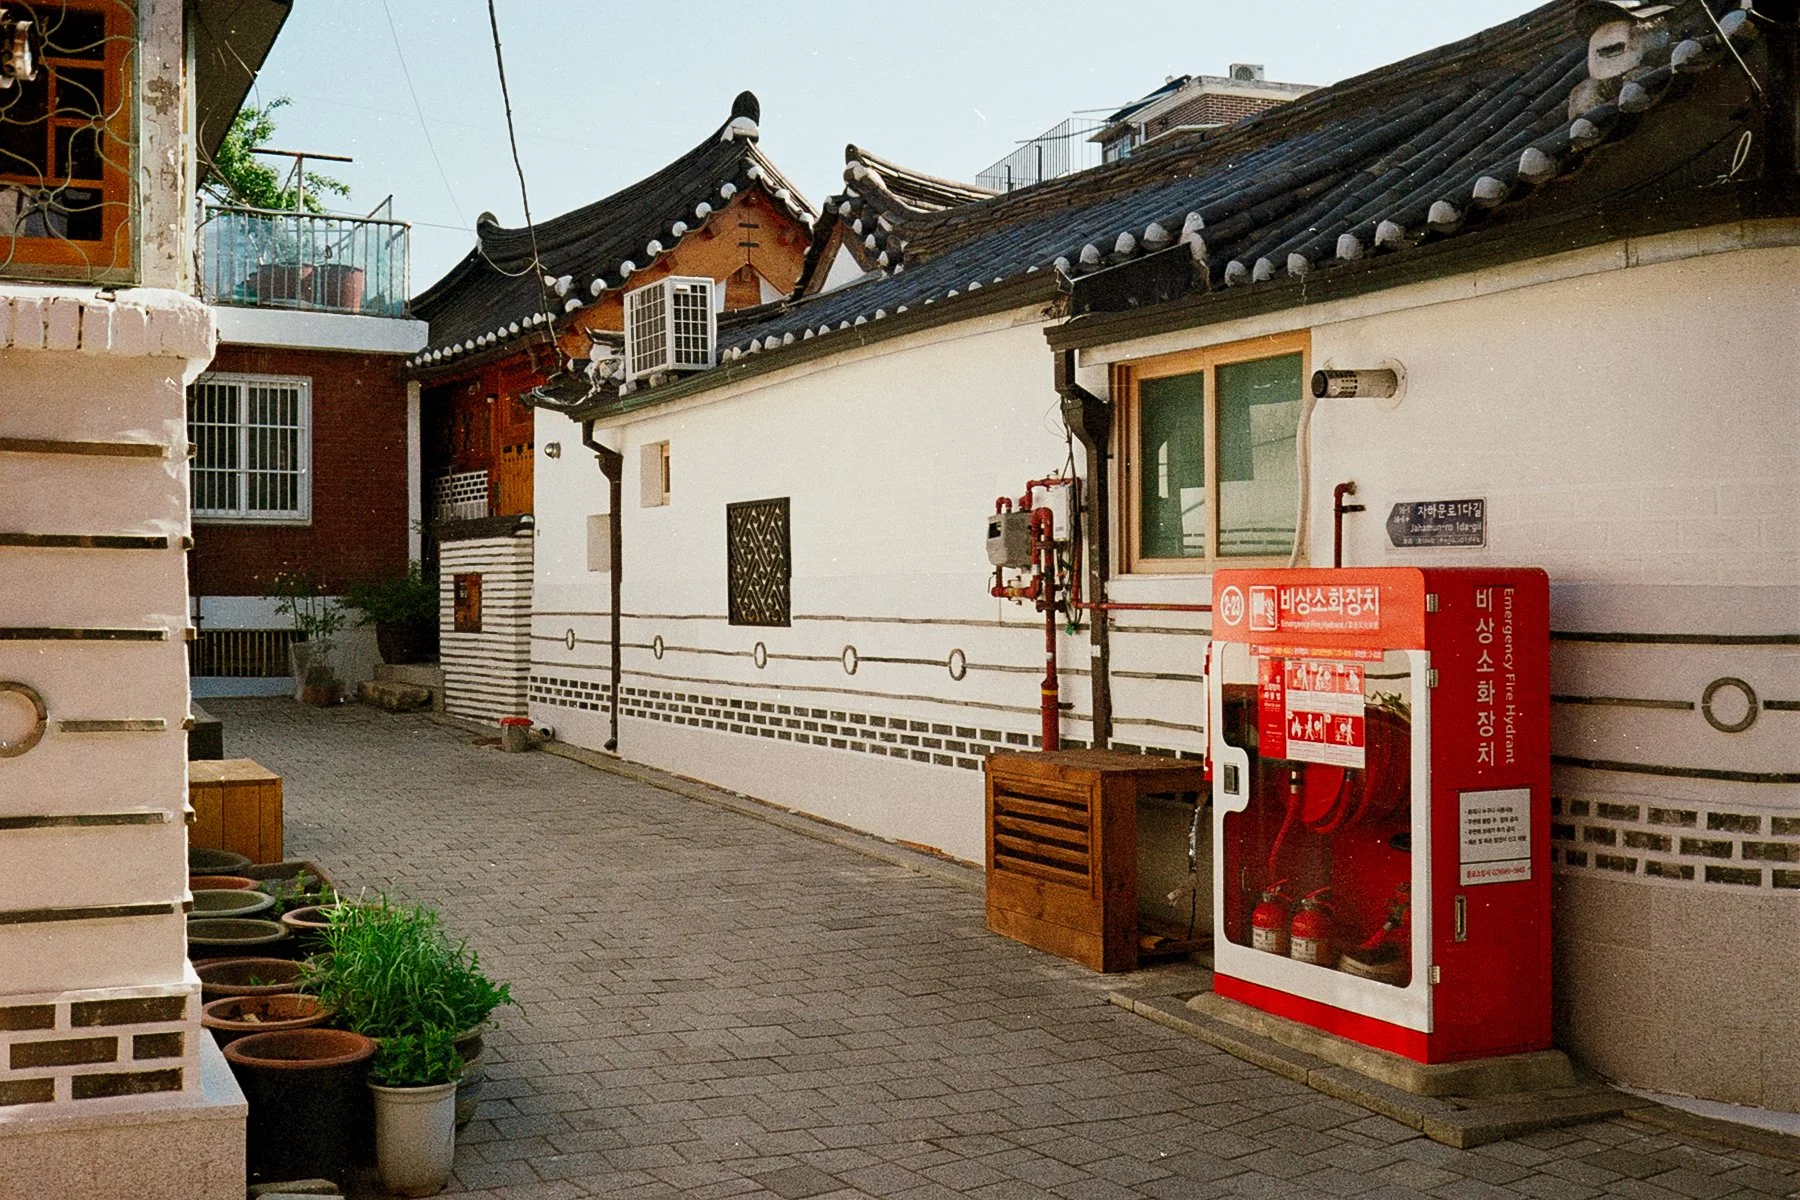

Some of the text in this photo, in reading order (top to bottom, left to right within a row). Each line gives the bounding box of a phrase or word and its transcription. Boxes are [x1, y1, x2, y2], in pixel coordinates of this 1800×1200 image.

[1417, 502, 1482, 519] 자하문로1다길
[1280, 586, 1380, 617] 비상소화장치
[1475, 587, 1496, 767] 비상소화장치
[1502, 588, 1517, 765] Emergency Fire Hydrant
